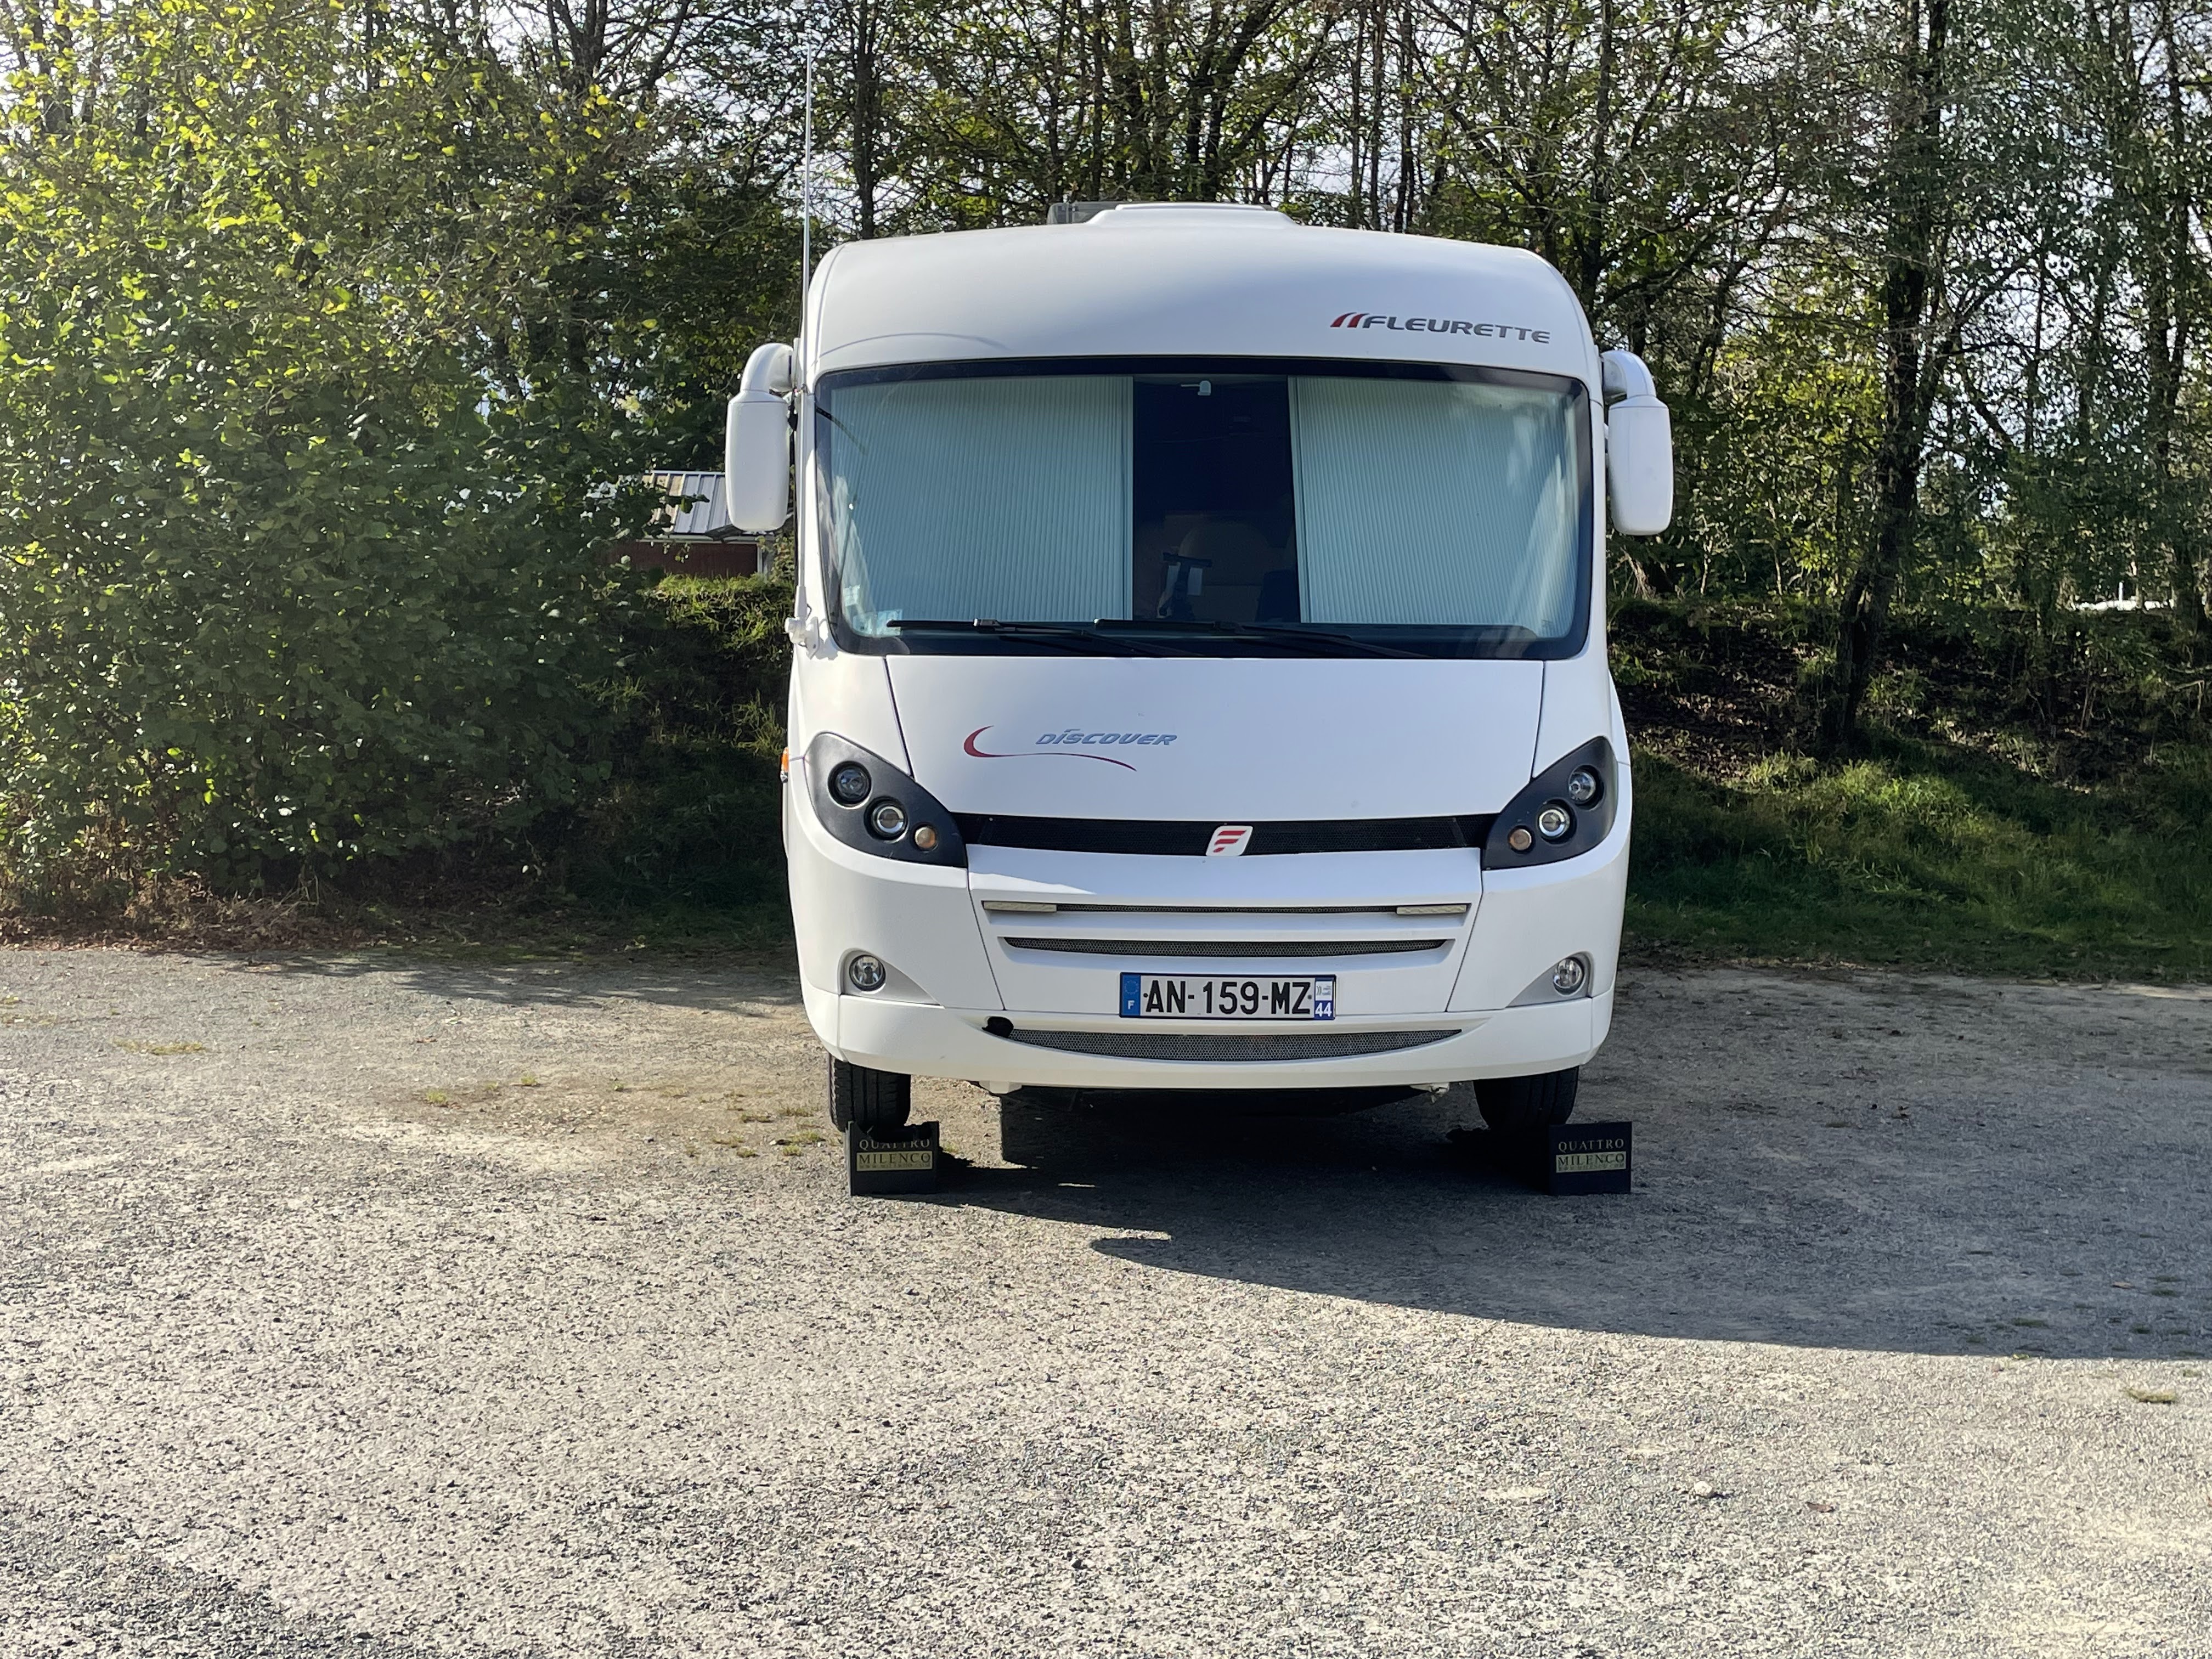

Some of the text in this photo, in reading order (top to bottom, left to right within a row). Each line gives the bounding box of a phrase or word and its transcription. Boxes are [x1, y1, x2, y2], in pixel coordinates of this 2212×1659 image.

[1362, 315, 1550, 343] FLEURETTE
[1146, 980, 1311, 1014] AN-159-MZ
[1127, 1001, 1135, 1009] F
[1315, 1002, 1332, 1017] 44
[1558, 1138, 1624, 1153] QUATTRO
[859, 1153, 931, 1164] MILENCO
[1558, 1153, 1624, 1165] MILENCO
